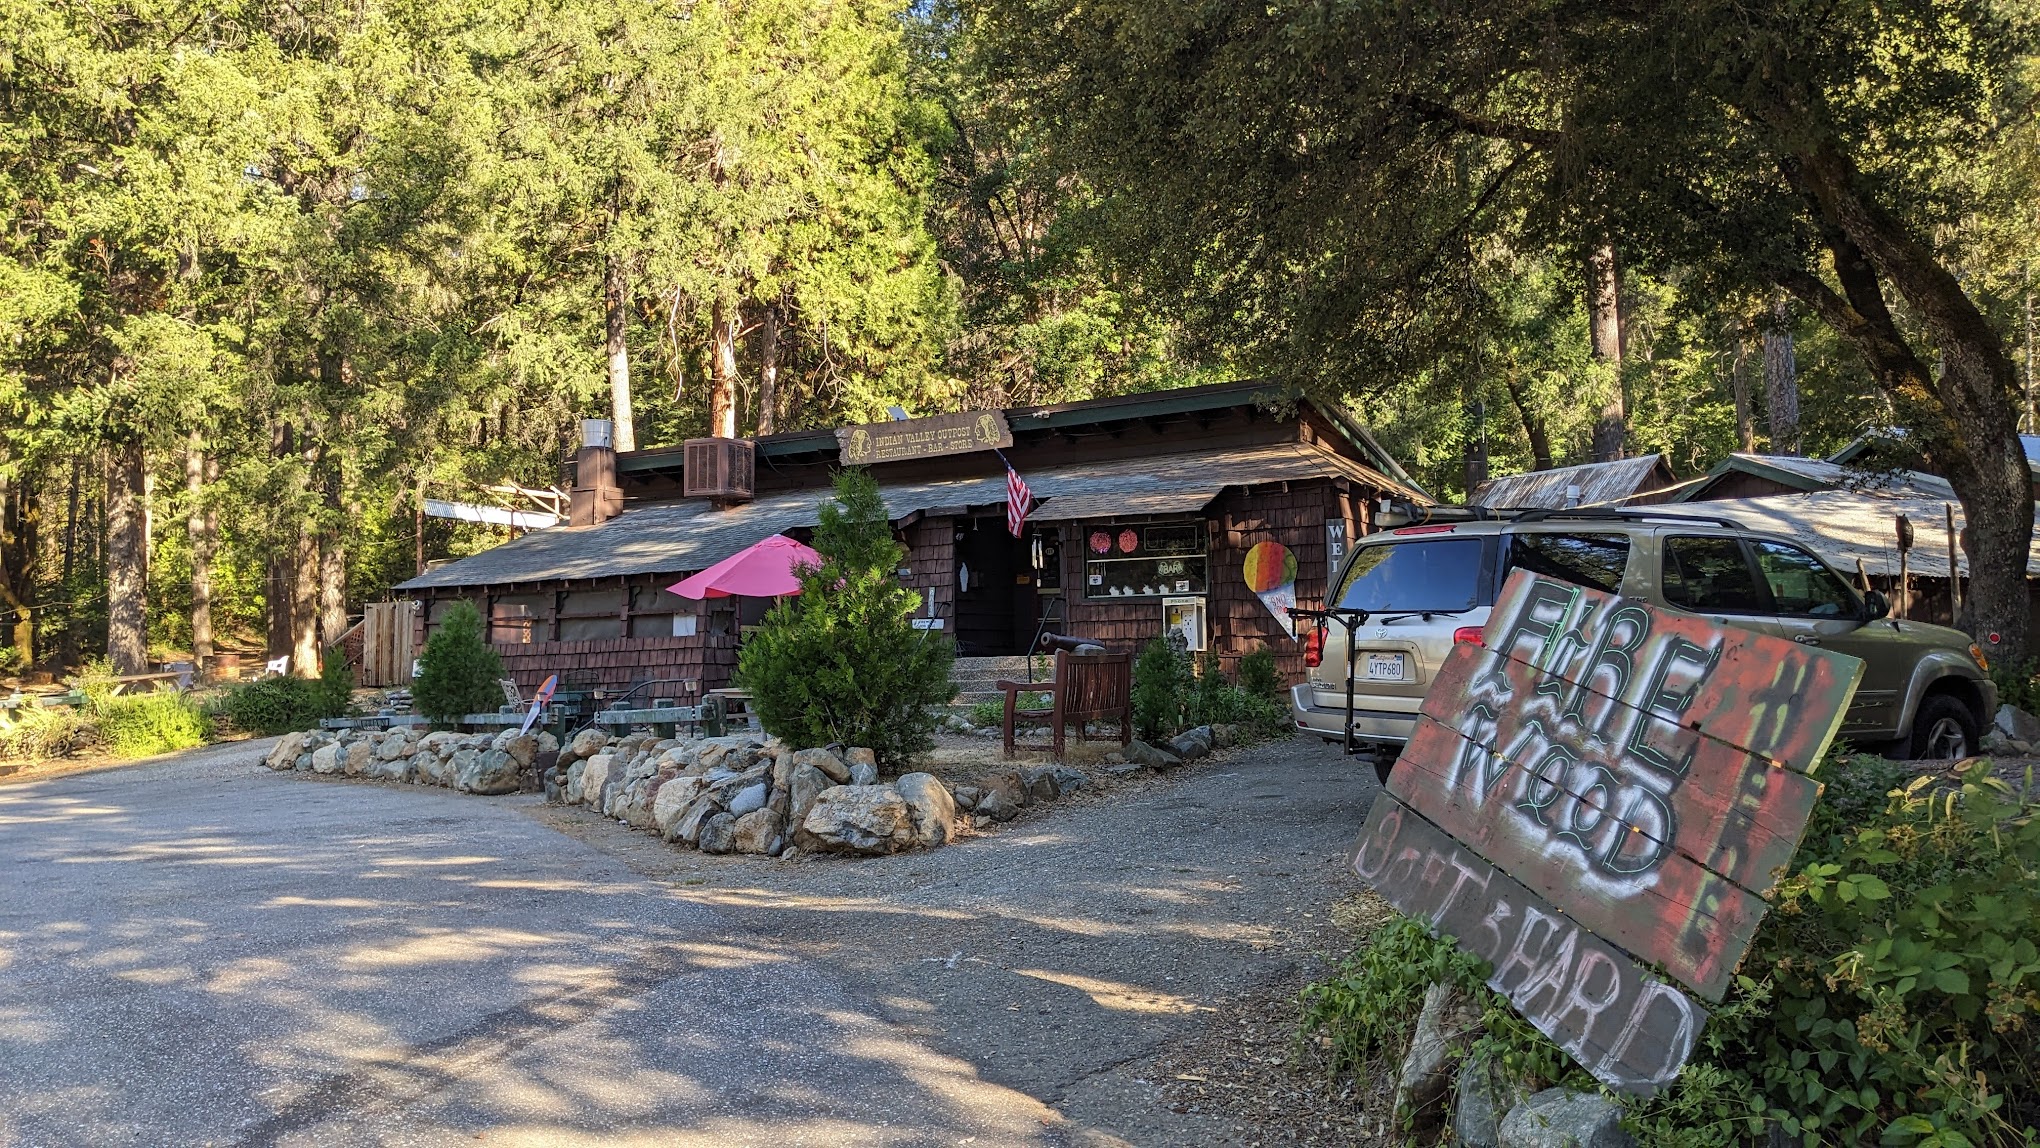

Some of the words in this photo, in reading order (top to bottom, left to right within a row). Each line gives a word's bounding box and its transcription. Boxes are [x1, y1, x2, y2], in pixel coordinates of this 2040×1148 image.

[875, 436, 903, 447] INDIAN
[905, 430, 936, 443] VALLEY
[937, 426, 971, 439] OUTPOST
[876, 445, 921, 459] RESTAURANT
[928, 442, 943, 453] BAR
[950, 439, 973, 450] STORE
[1163, 564, 1178, 574] BAR
[1369, 662, 1401, 675] 4YTP680
[1473, 579, 1723, 776] FIRE
[1452, 702, 1679, 875] WOOD
[1492, 907, 1695, 1085] HARD
